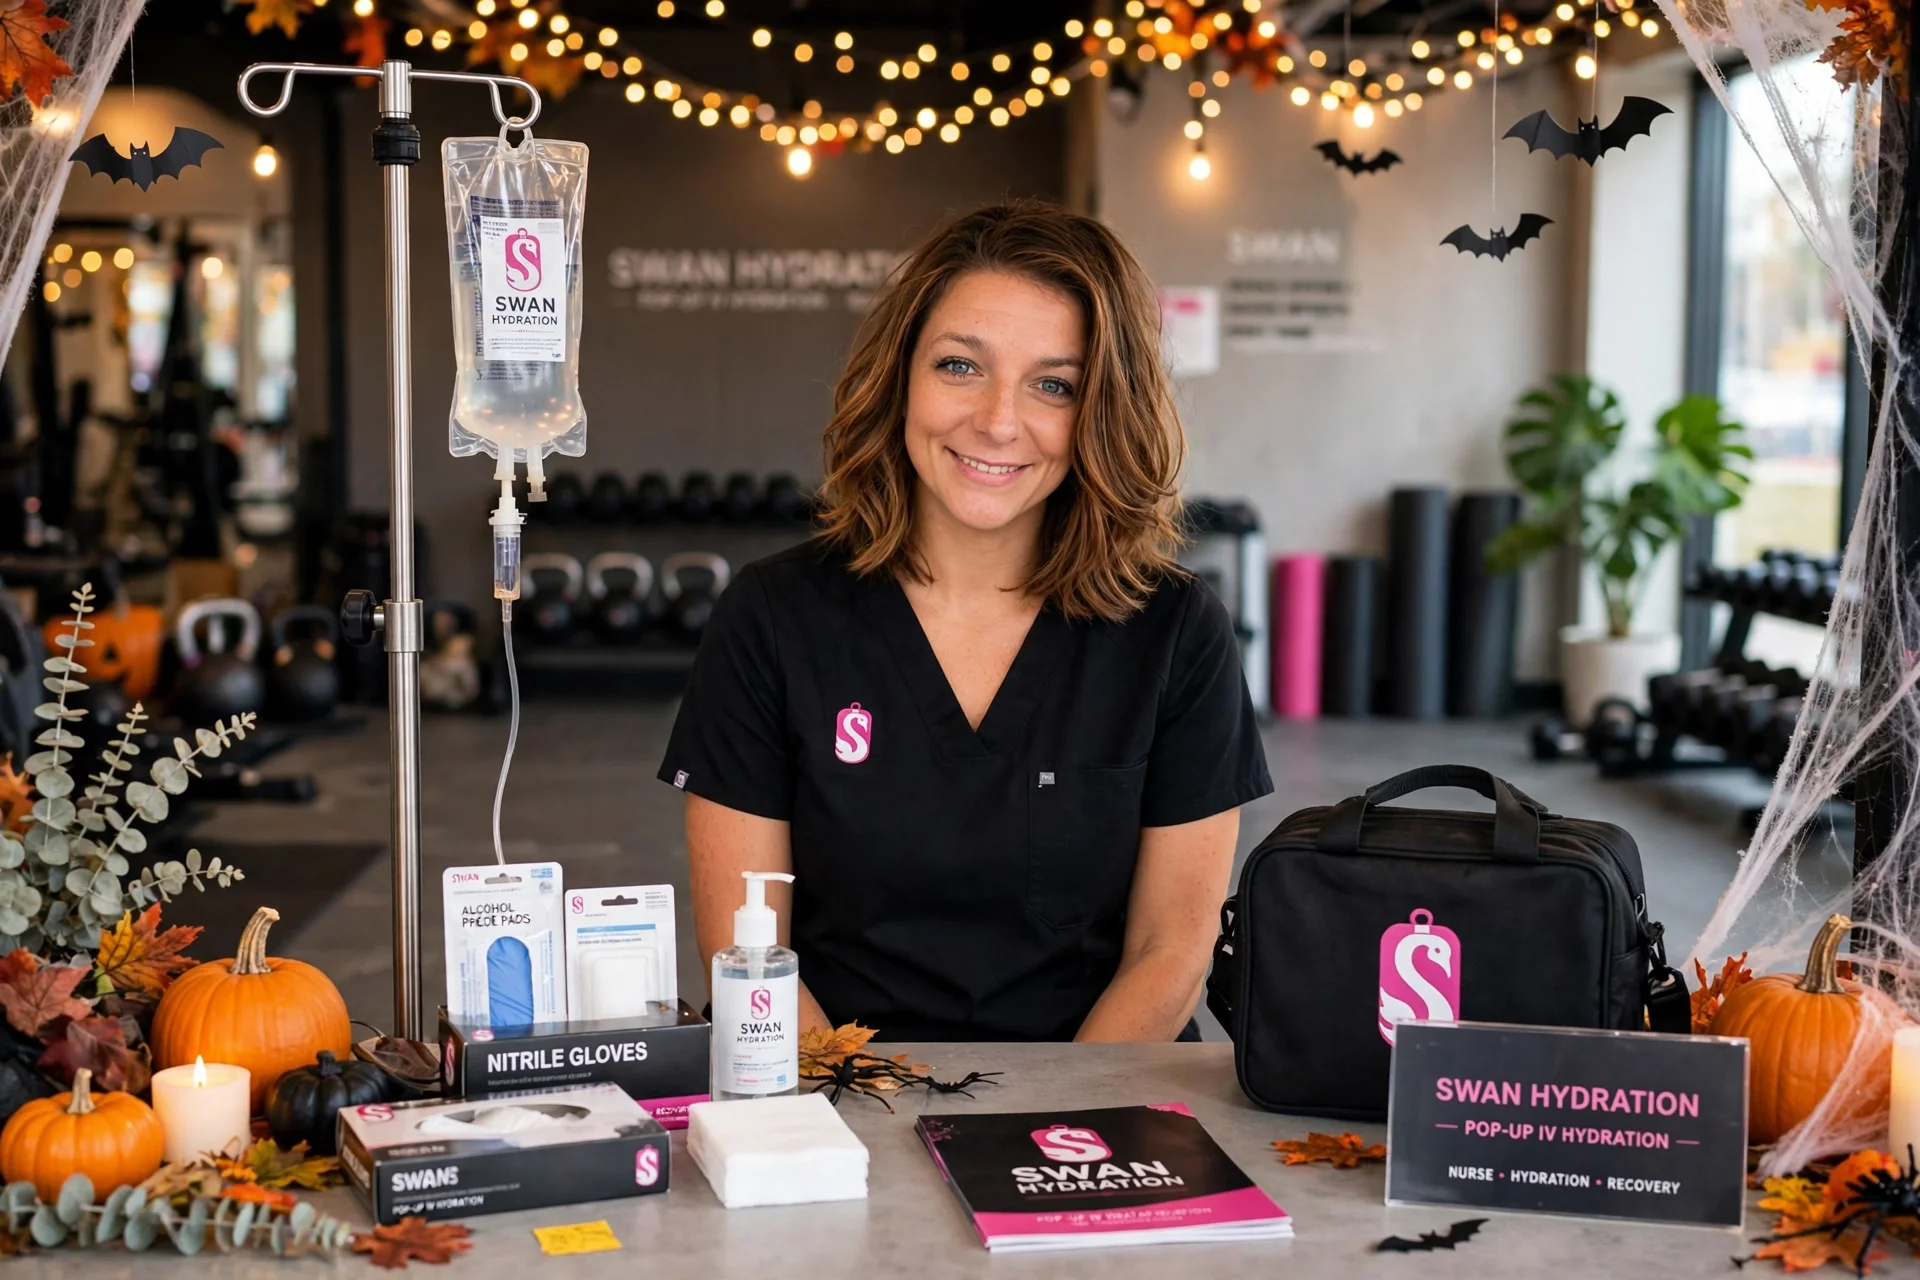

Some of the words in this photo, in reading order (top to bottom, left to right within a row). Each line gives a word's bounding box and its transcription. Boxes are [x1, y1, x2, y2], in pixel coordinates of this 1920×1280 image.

[495, 296, 556, 313] SWAN
[491, 314, 558, 326] HYDRATION
[462, 902, 515, 916] ALCOHOL
[501, 914, 531, 927] PADS
[740, 1021, 782, 1035] SWAN
[736, 1033, 785, 1044] HYDRATION
[487, 1048, 565, 1073] NITRILE
[569, 1041, 648, 1067] GLOVES
[1435, 1077, 1521, 1106] SWAN
[1531, 1084, 1699, 1118] HYDRATION
[1464, 1120, 1534, 1141] POP-UP
[1538, 1125, 1557, 1142] IV
[1562, 1127, 1669, 1149] HYDRATION
[391, 1166, 460, 1192] SWANS
[1011, 1160, 1170, 1183] SWAN
[1448, 1166, 1494, 1182] NURSE
[1510, 1170, 1590, 1188] HYDRATION
[1607, 1177, 1681, 1195] RECOVERY
[1016, 1175, 1185, 1194] HYDRATION
